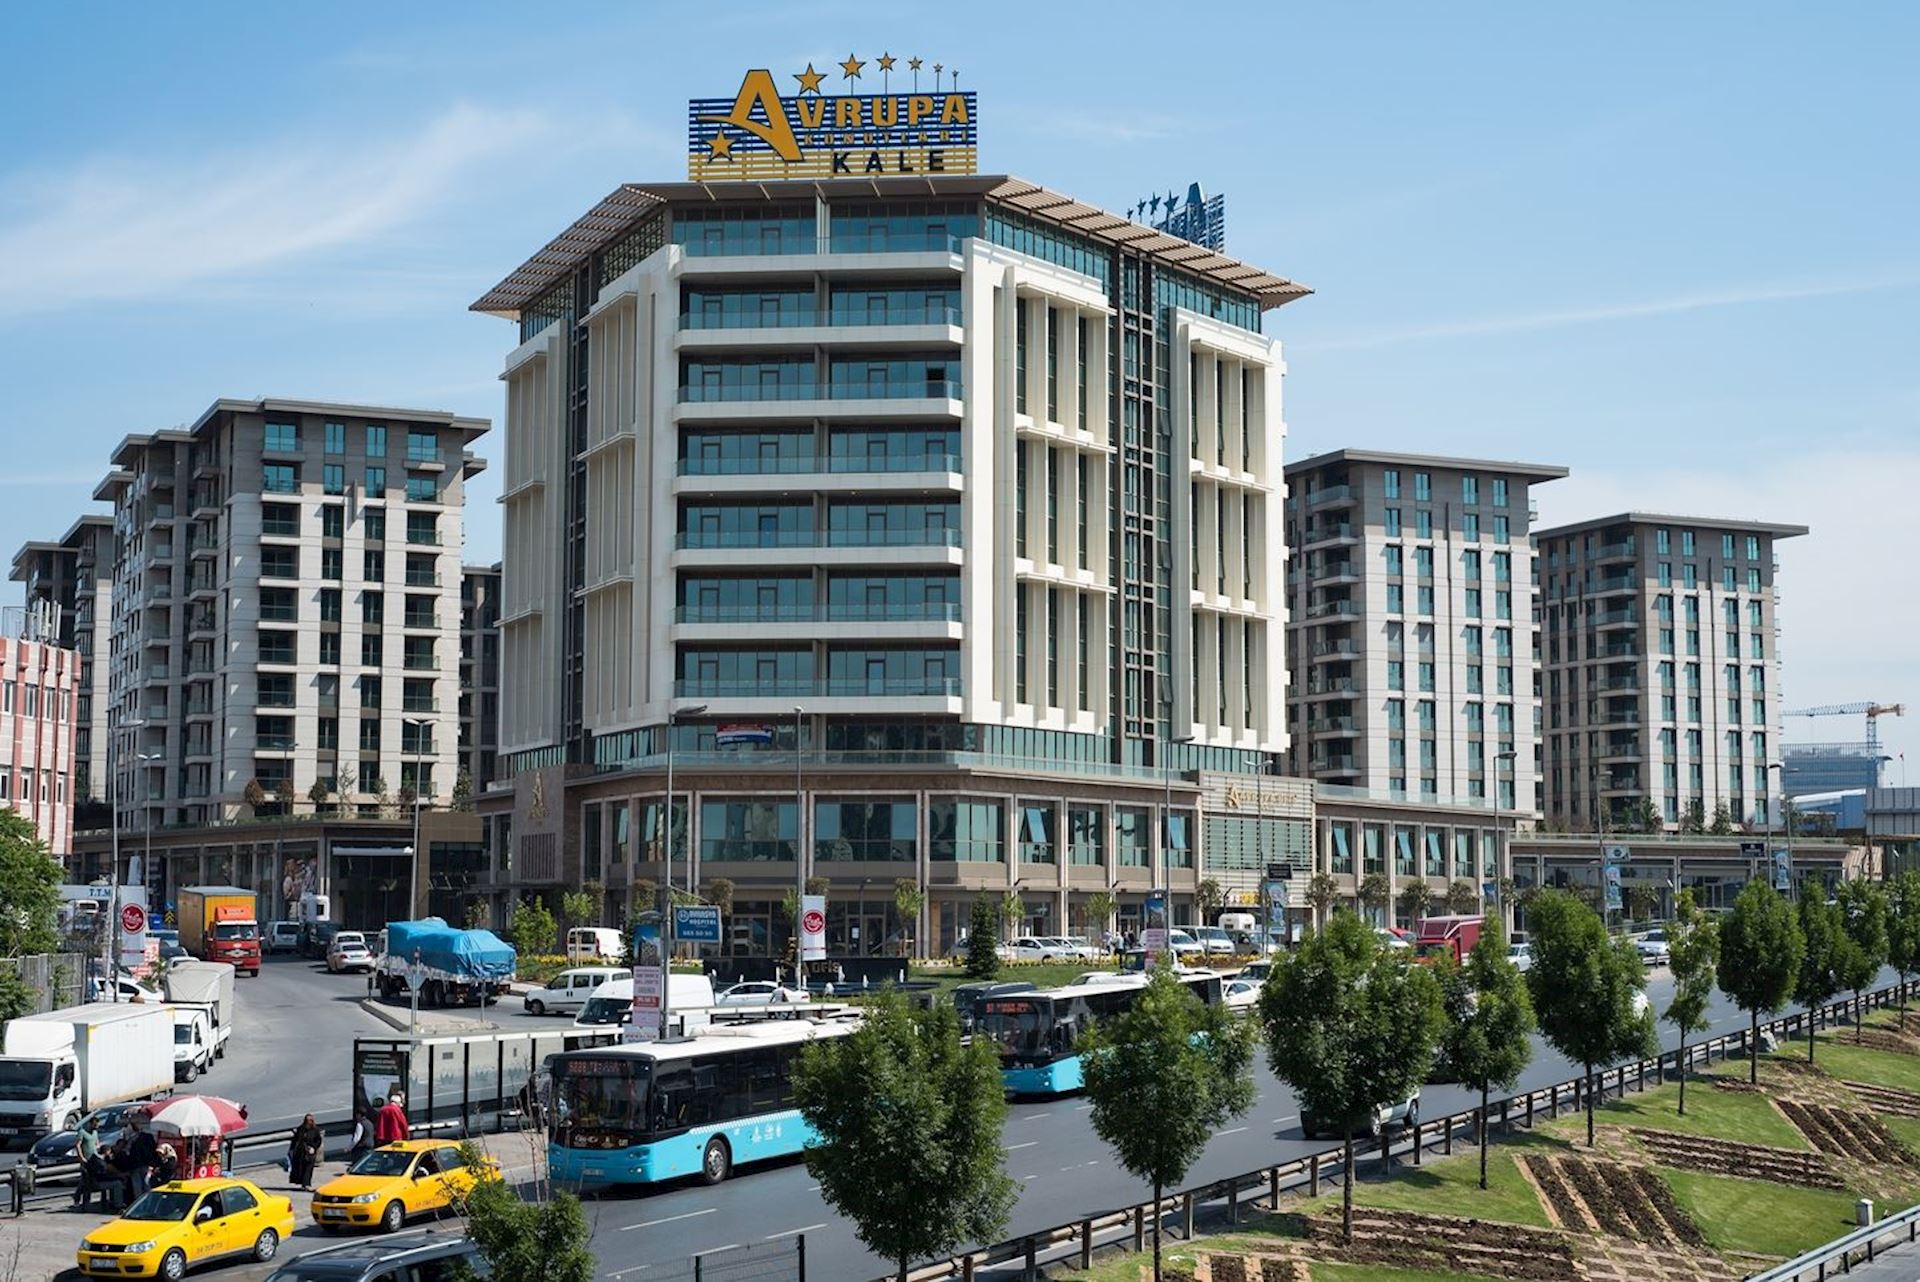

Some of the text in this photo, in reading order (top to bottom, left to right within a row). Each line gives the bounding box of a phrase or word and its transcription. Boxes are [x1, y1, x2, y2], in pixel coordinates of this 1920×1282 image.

[698, 69, 969, 161] AVRUPA
[804, 130, 967, 145] KONUTLARI
[833, 150, 945, 173] KALE
